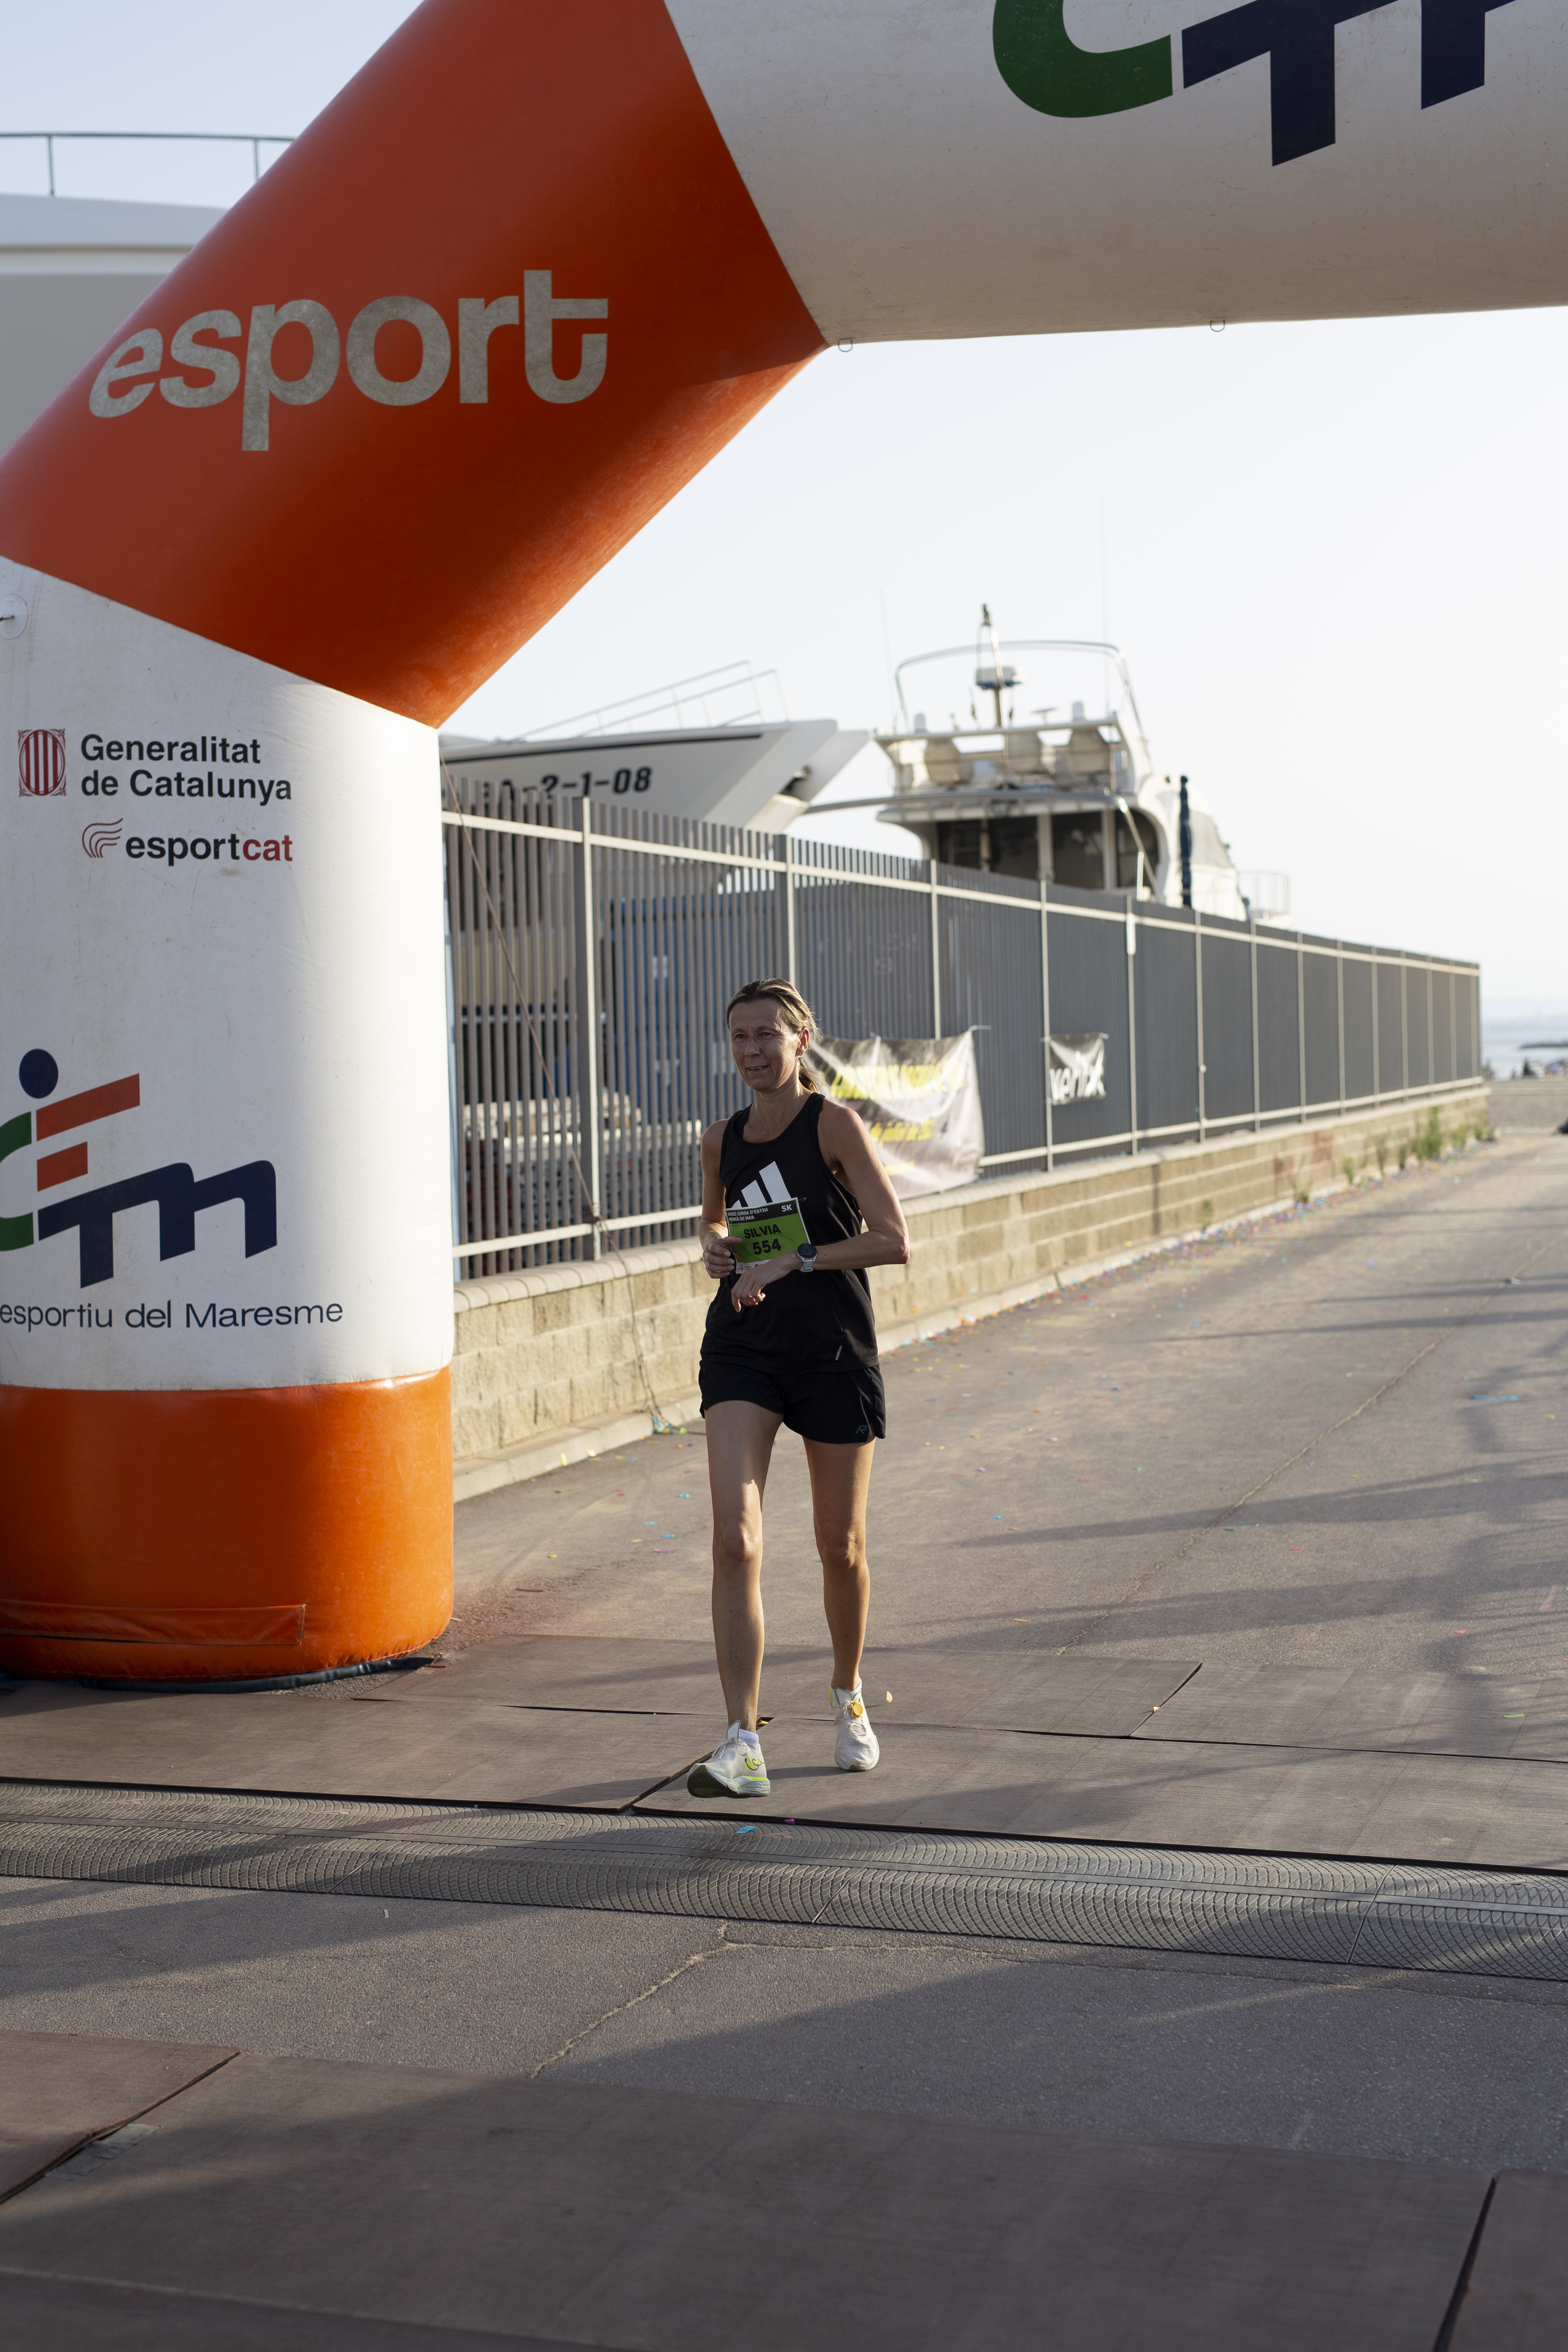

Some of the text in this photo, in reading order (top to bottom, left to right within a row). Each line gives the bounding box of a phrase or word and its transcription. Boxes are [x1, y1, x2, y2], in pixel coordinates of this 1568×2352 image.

[89, 269, 609, 451] esport
[81, 733, 261, 764] Generalitat
[81, 769, 292, 806] de Catalunya
[126, 833, 293, 867] esportcat
[744, 1224, 782, 1239] SILVIA
[753, 1238, 781, 1255] 554
[0, 1299, 343, 1332] esportiu del Maresme
